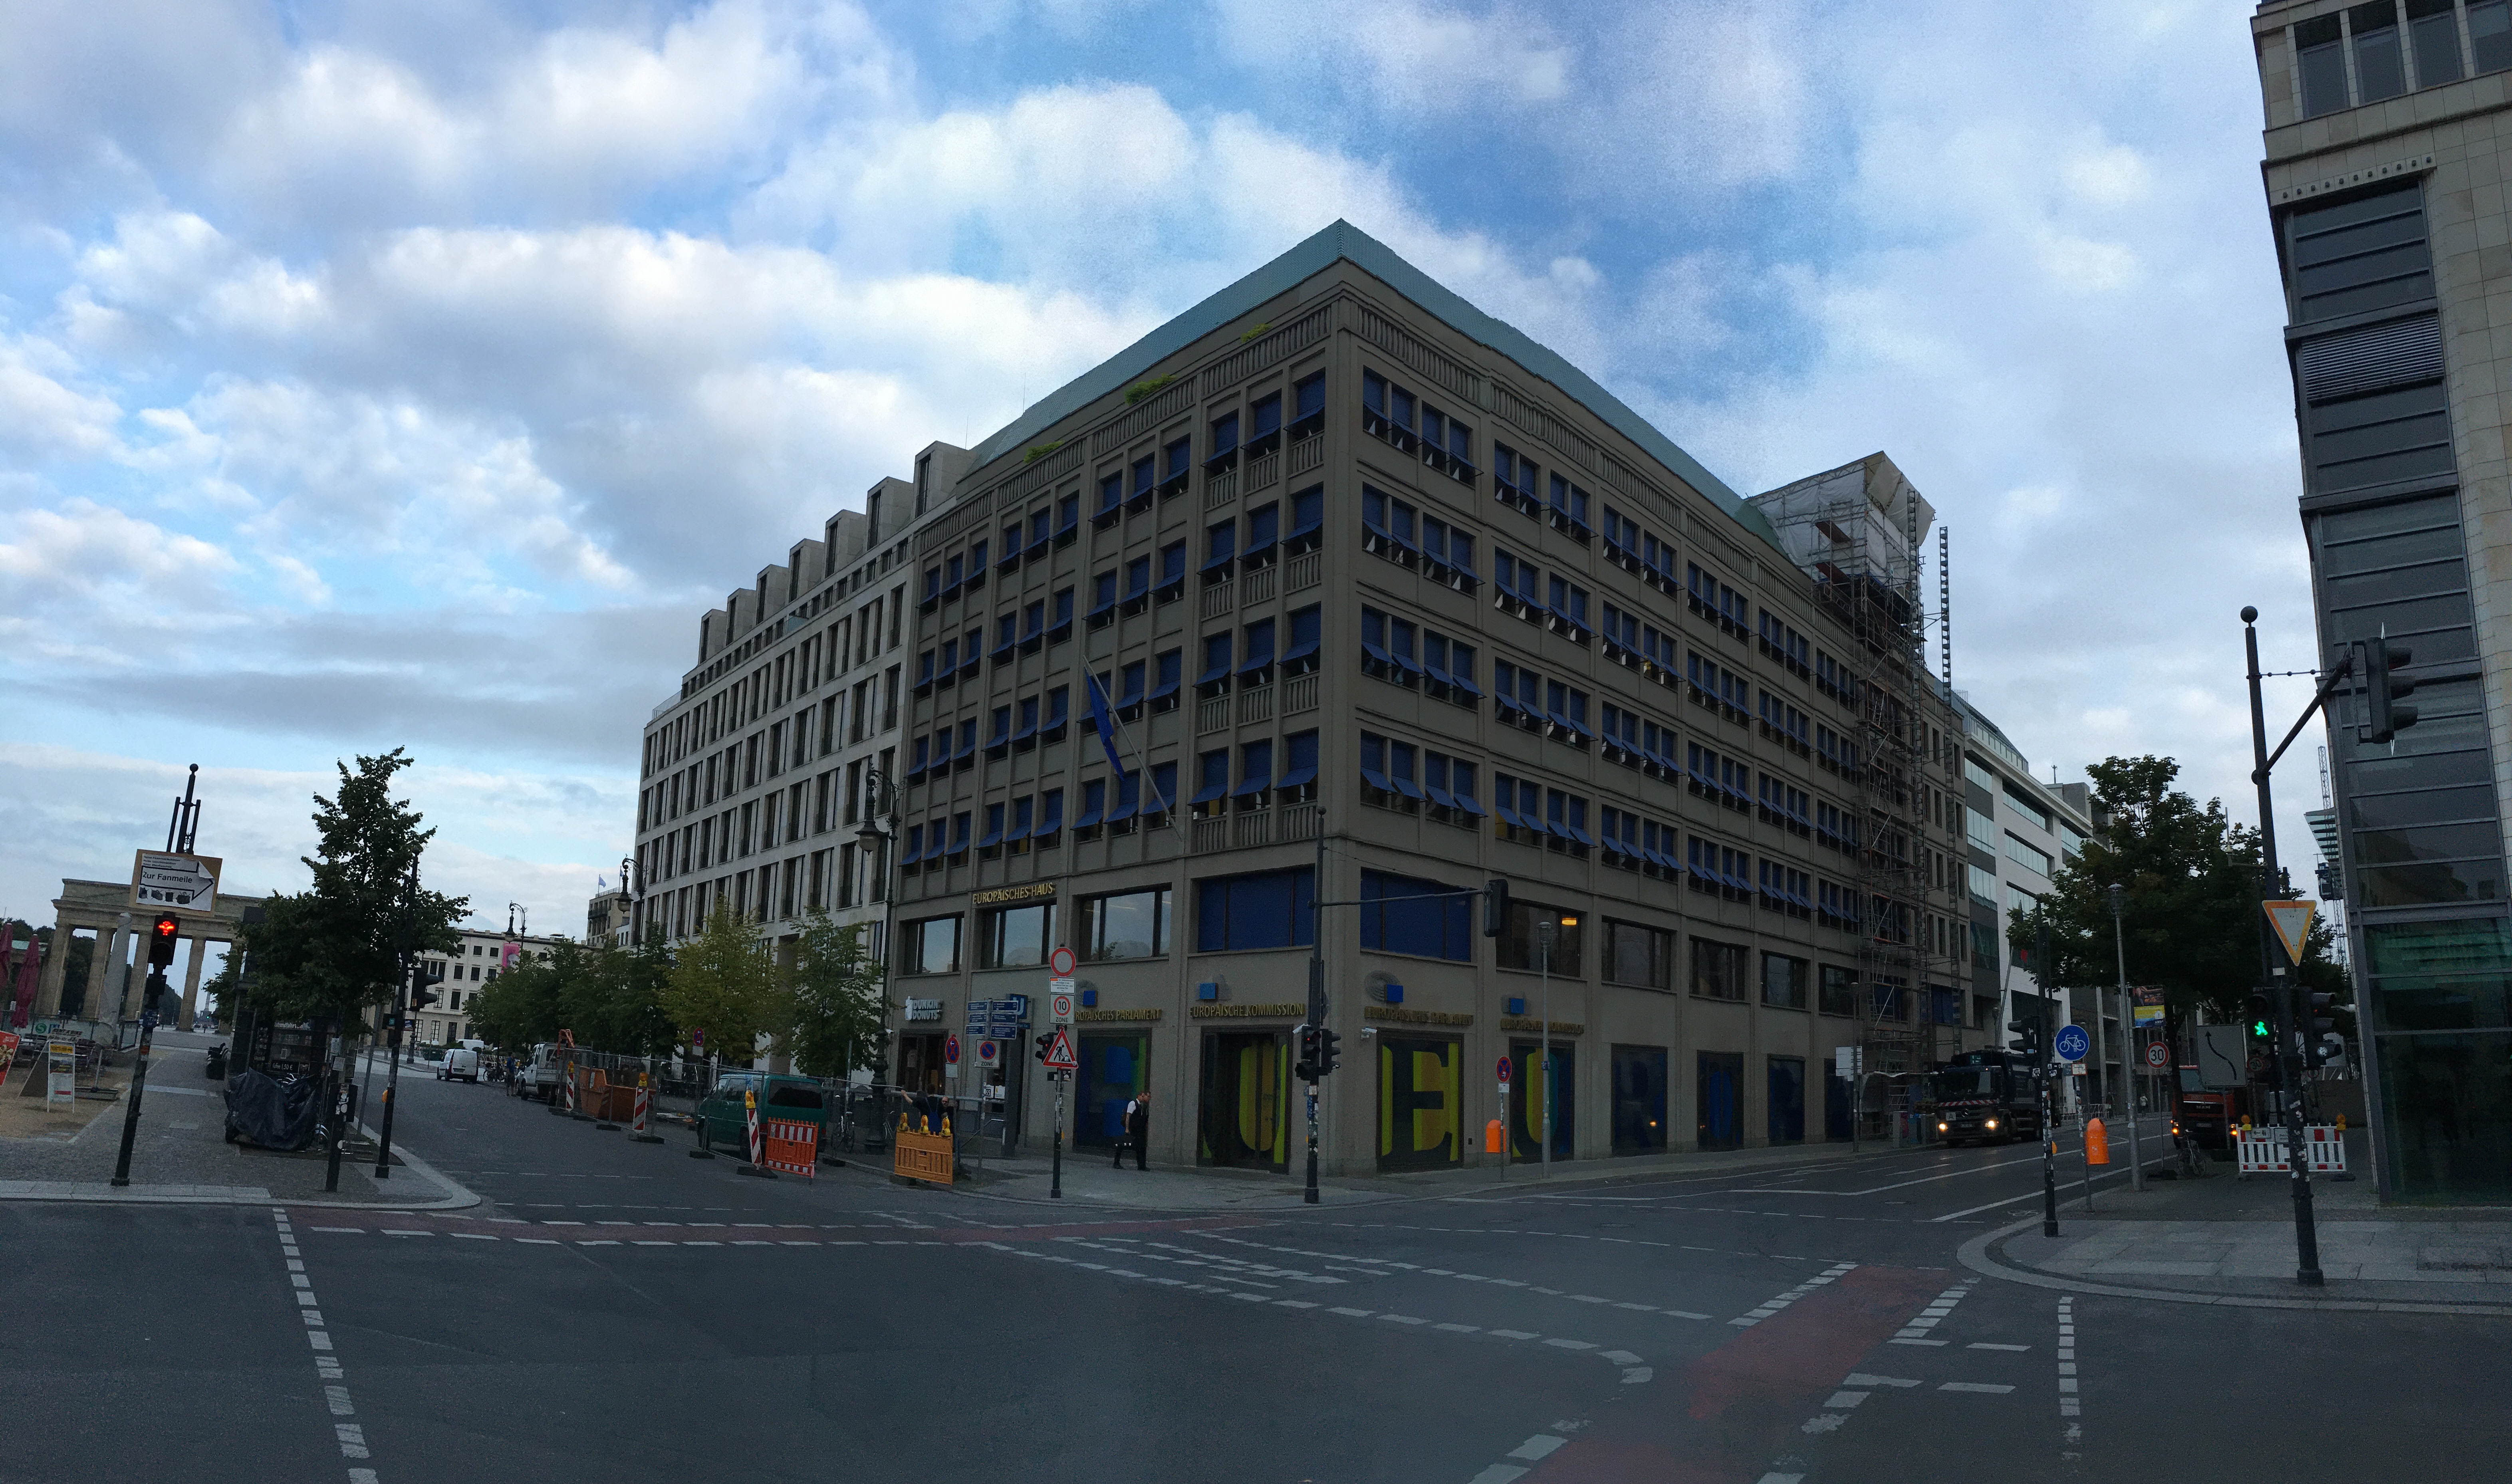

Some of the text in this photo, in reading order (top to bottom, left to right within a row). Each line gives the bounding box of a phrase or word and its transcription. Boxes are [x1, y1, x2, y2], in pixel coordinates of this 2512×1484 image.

[157, 873, 192, 883] Fanmeile
[973, 882, 1053, 904] EUROPÄISCHES HAUS
[1059, 1001, 1067, 1010] 10
[1190, 1003, 1304, 1017] EUROPÄISCHE KOMMISSION
[913, 1010, 939, 1020] DONUTS
[1075, 1009, 1161, 1021] ROPÄISCHES PARLAMENT
[2151, 1049, 2164, 1061] 30
